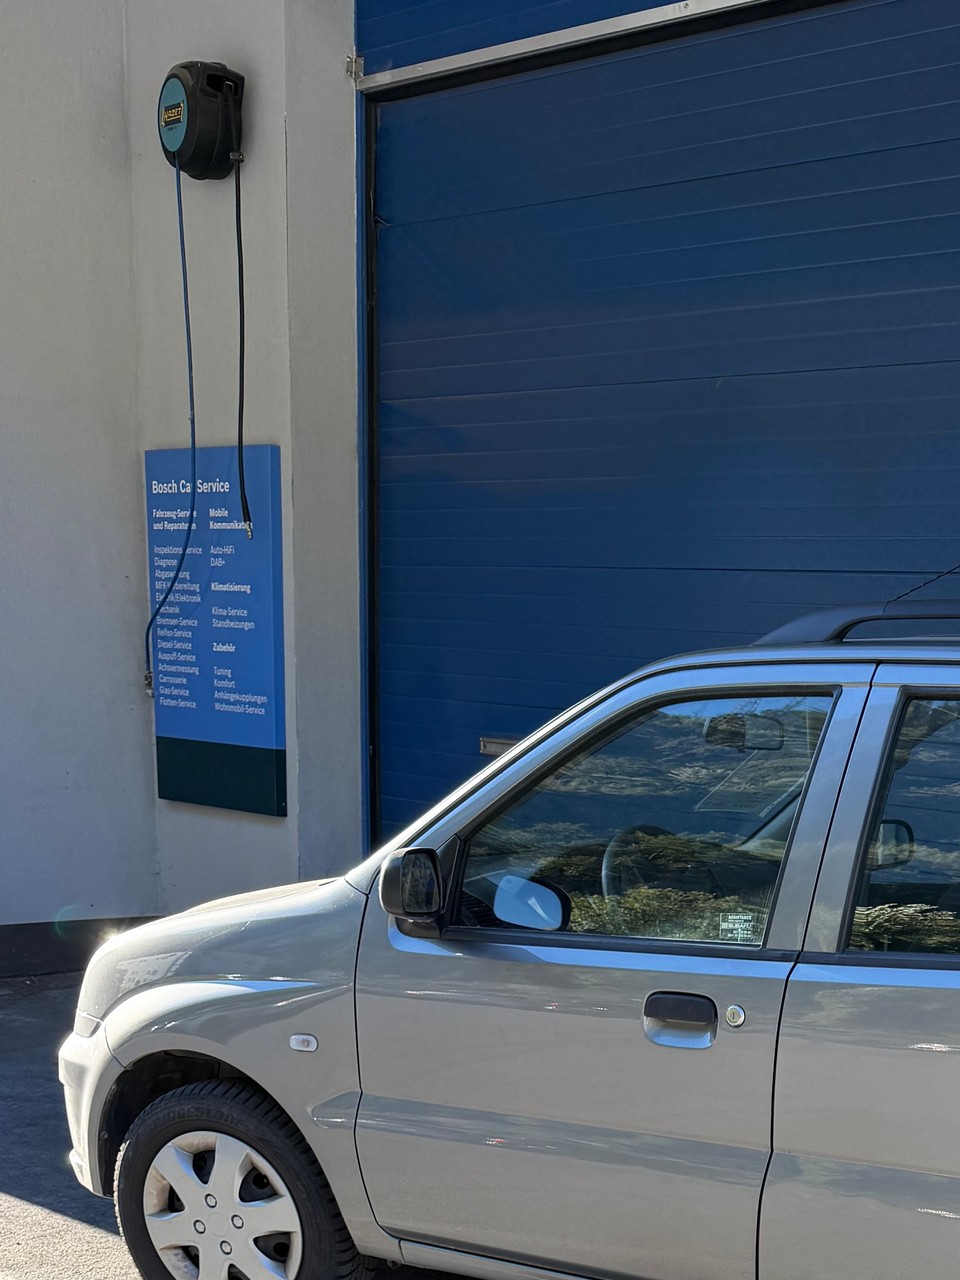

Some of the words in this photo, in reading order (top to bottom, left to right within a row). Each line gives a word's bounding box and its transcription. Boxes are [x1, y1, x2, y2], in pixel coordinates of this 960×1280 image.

[164, 107, 181, 120] HAZET
[152, 480, 178, 494] Bosch
[180, 480, 194, 493] Ca
[197, 478, 230, 493] Service
[152, 509, 197, 519] Fahrzeug-Servie
[209, 508, 229, 517] Mobile
[153, 521, 164, 530] und
[164, 521, 196, 532] Reparaturn
[209, 520, 253, 530] Kommunikatn
[154, 545, 202, 555] Inspektionservice
[210, 545, 235, 555] Auto-HiFi
[154, 557, 178, 568] Diagnose
[210, 557, 225, 567] DAB+
[155, 581, 200, 592] MFK-Vrbereitung
[211, 582, 251, 594] Klimatisierung
[156, 604, 180, 613] echanik
[212, 606, 248, 617] Klima-Service
[157, 616, 198, 626] Bremsen-Service
[212, 619, 255, 631] Standheizungen
[157, 628, 192, 638] Reifen-Service
[157, 640, 192, 650] Diesel-Service
[212, 642, 236, 652] Zubehör
[158, 651, 196, 662] Auspuff-Service
[158, 663, 199, 675] Achsvermessung
[213, 666, 232, 678] Tuning
[159, 674, 187, 684] Carrosserie
[213, 679, 236, 689] Komfort
[159, 686, 190, 696] Glas-Service
[214, 690, 268, 704] Anhängekupplungen
[159, 697, 197, 708] Flotten-Service
[214, 702, 266, 715] Wohnmobil-Service
